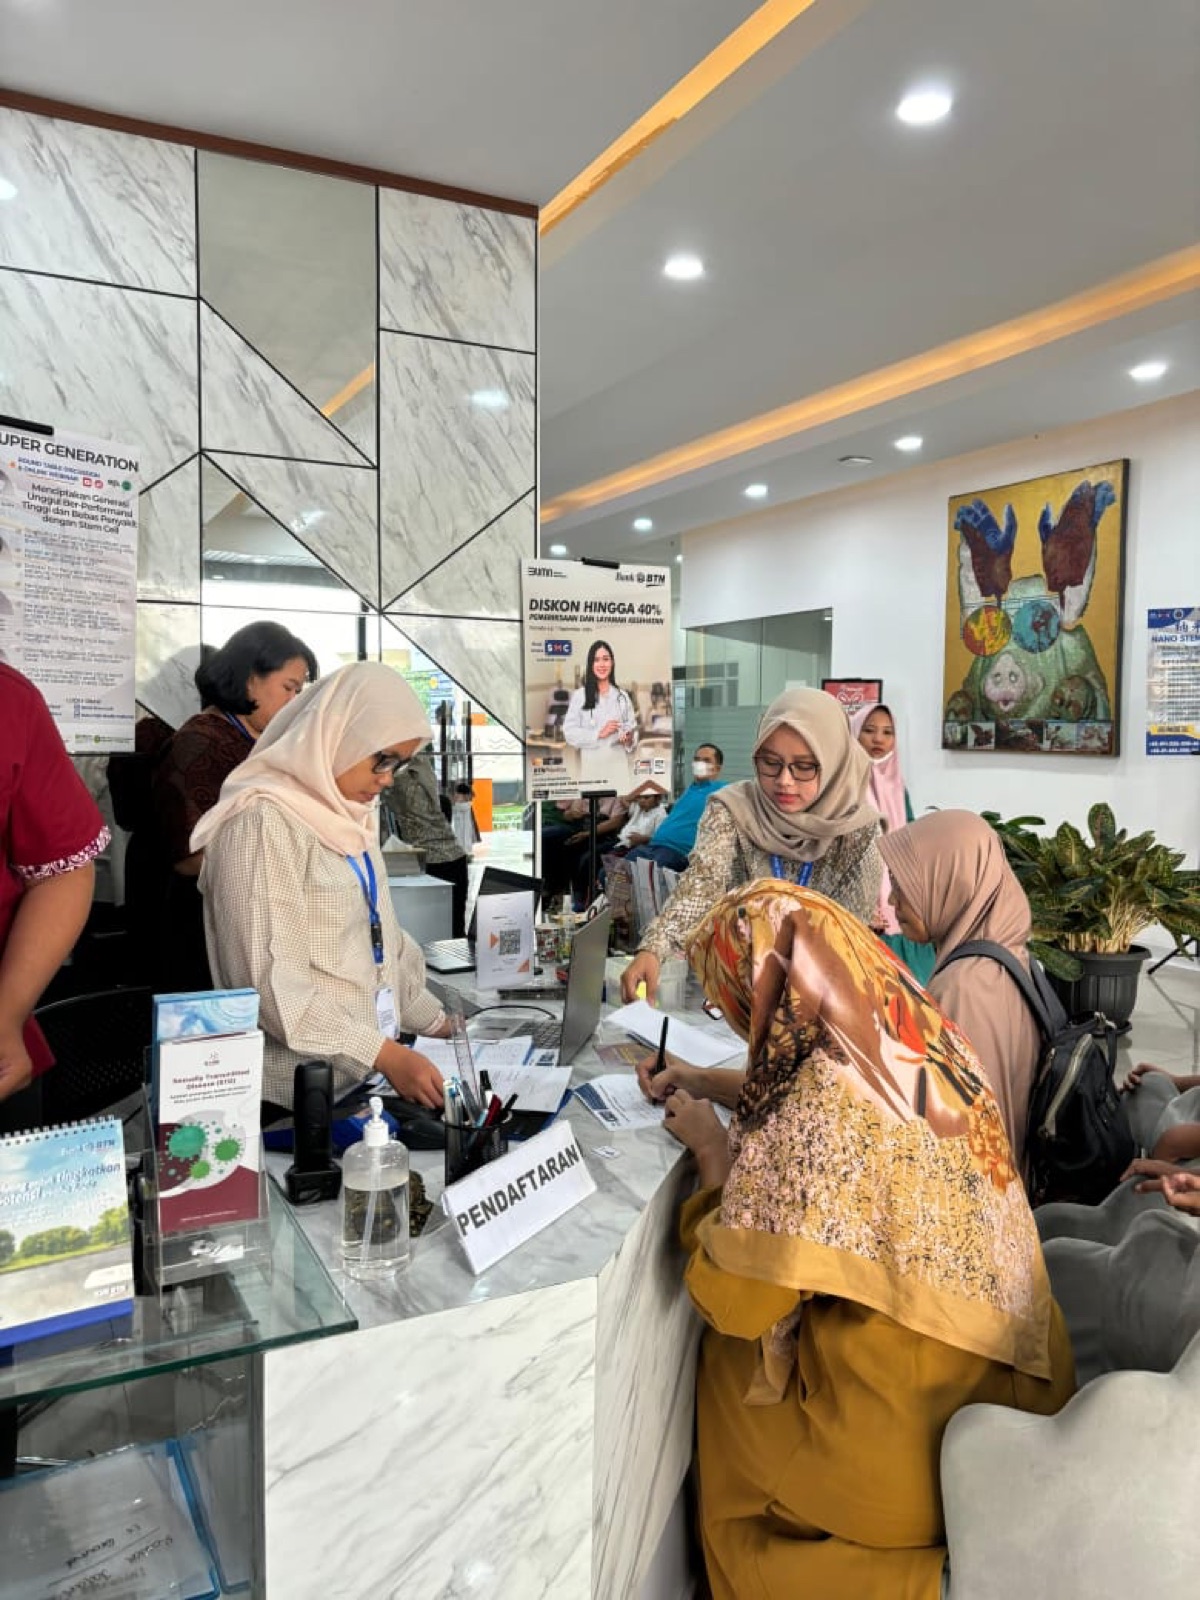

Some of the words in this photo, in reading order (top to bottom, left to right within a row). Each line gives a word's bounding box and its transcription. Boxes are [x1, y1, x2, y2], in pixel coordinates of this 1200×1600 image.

[45, 442, 139, 473] GENERATION
[27, 492, 61, 506] Unggul
[31, 483, 91, 501] Menciptakan
[22, 501, 52, 514] Tinggi
[53, 506, 69, 517] dan
[72, 511, 98, 521] Bebas
[42, 515, 76, 528] dengan
[79, 520, 102, 531] Stem
[103, 524, 119, 534] Cell
[646, 574, 666, 583] BTN
[529, 598, 580, 612] DISKON
[584, 601, 635, 615] HINGGA
[638, 604, 662, 616] 40%
[1151, 634, 1178, 643] NANO
[456, 1144, 580, 1236] PENDAFTARAN
